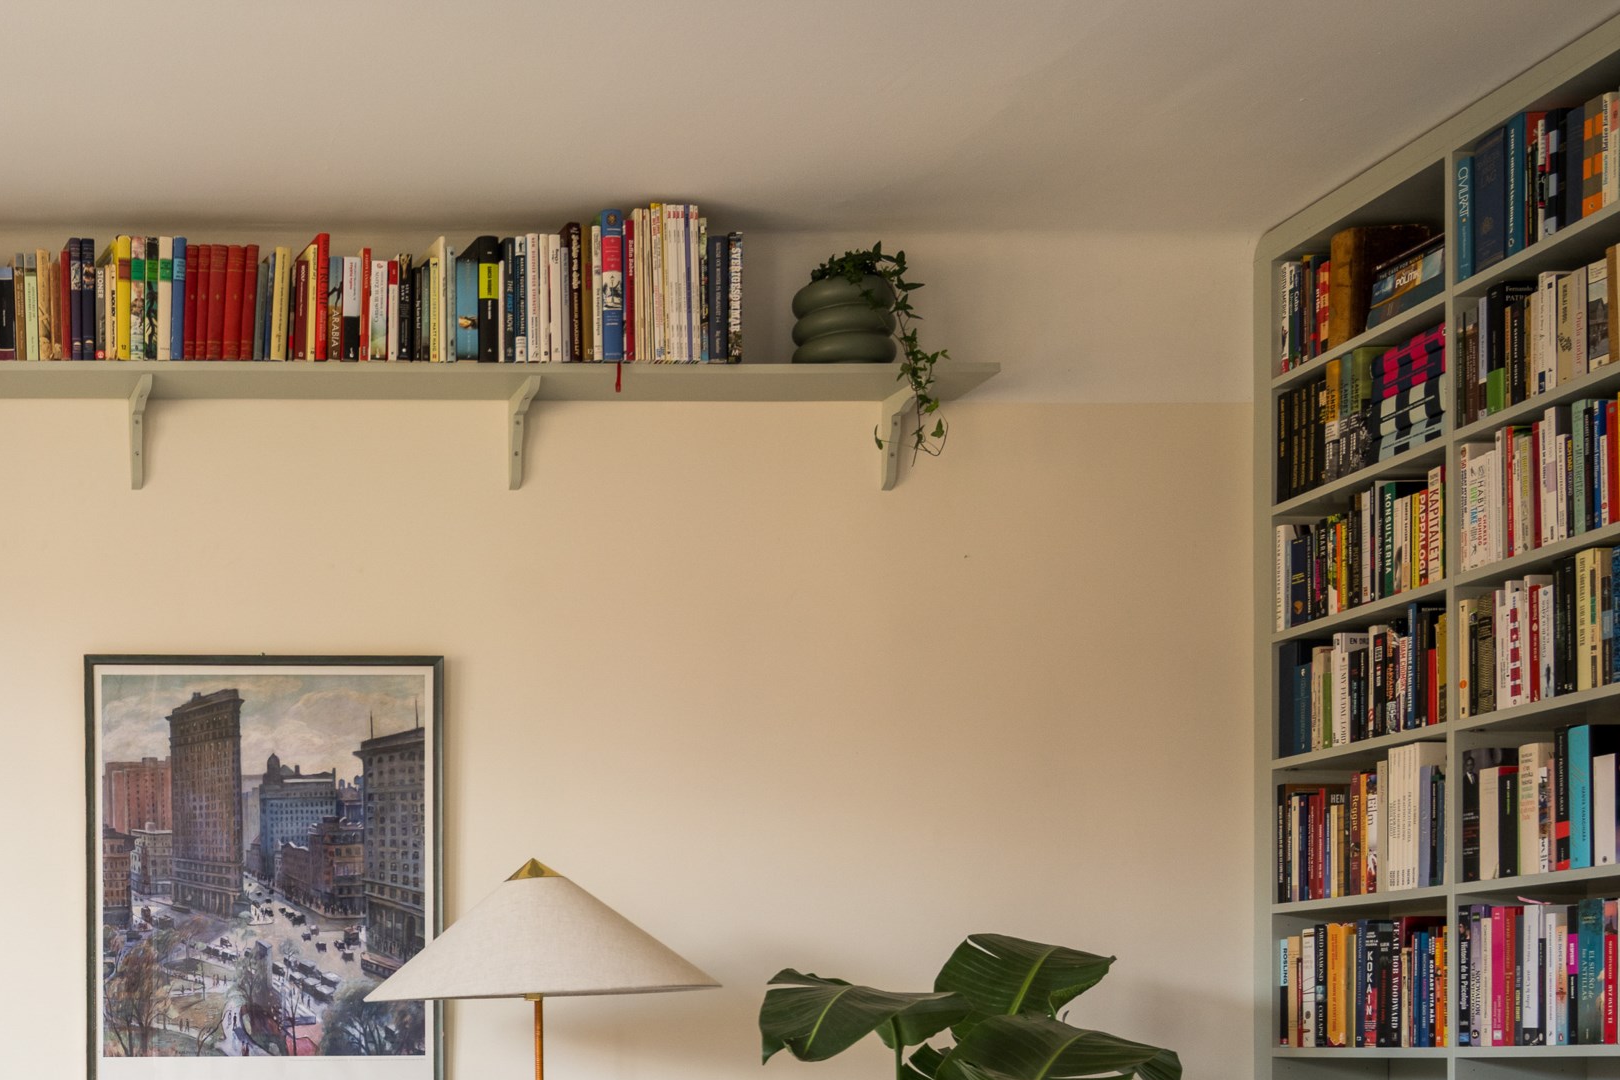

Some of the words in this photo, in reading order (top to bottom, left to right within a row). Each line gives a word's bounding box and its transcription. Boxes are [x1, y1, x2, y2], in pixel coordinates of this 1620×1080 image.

[730, 248, 742, 332] SVERIGESOMMAR
[332, 310, 340, 348] ARABIA
[1462, 458, 1466, 470] 50
[1429, 488, 1439, 562] KAPITALET
[1340, 672, 1346, 686] MY
[1352, 794, 1360, 831] Reggae
[1368, 798, 1376, 826] Film
[1460, 964, 1468, 972] de
[1589, 950, 1594, 960] EL
[1460, 981, 1468, 1010] Psicología
[1588, 990, 1594, 998] de
